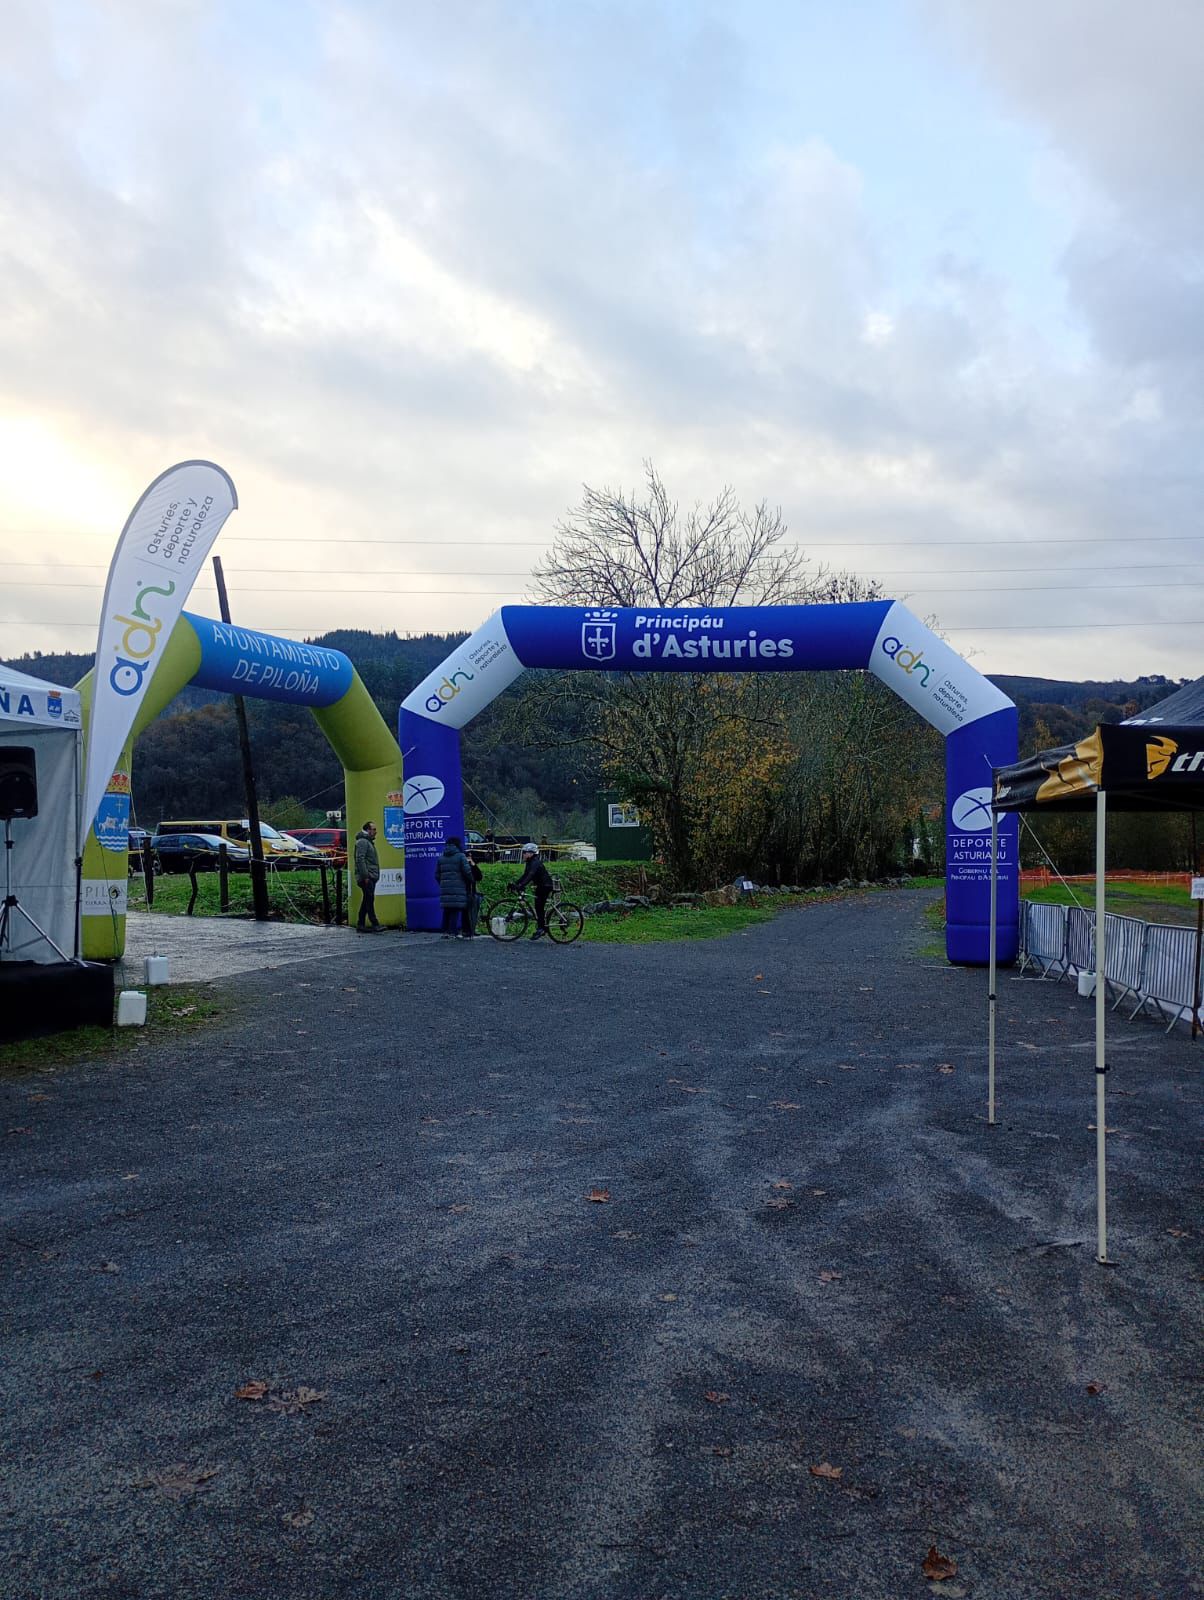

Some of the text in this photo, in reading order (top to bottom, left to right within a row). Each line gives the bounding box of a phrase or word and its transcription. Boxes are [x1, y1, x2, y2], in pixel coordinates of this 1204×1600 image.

[163, 497, 198, 559] deporte y
[178, 496, 214, 564] naturaleza
[635, 615, 724, 632] Principáu
[212, 625, 340, 671] AYUNTAMIENTO
[232, 659, 320, 694] DE PILOÑA
[932, 692, 964, 722] naturaleza
[938, 687, 962, 709] deporte
[953, 838, 1007, 848] DEPORE
